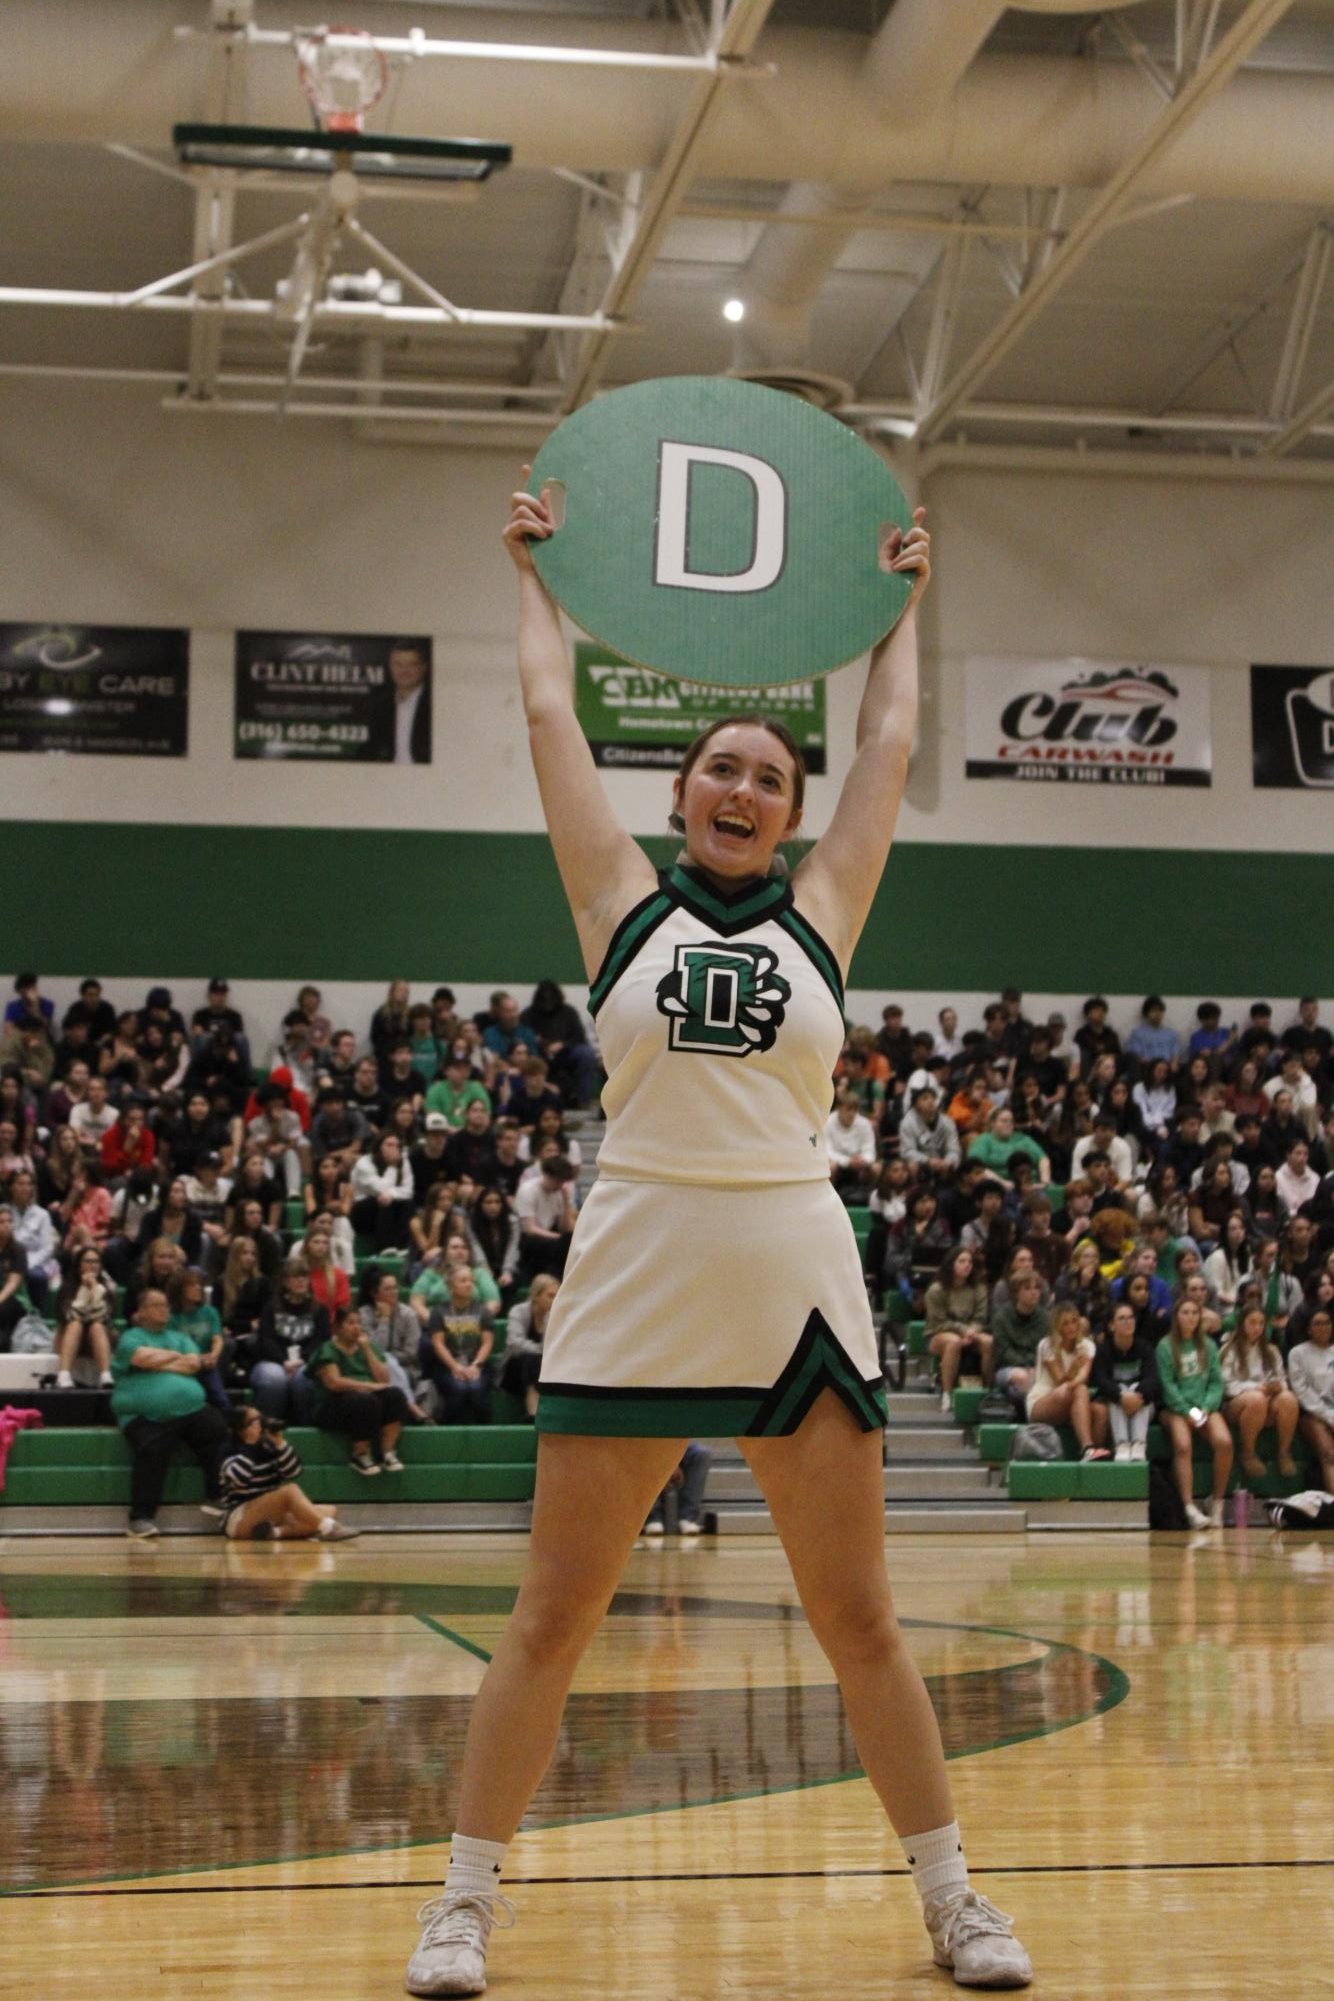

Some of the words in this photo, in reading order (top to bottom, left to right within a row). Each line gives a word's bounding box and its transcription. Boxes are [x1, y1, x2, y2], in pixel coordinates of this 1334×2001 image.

[653, 439, 788, 594] D
[251, 662, 317, 682] CLINT
[322, 664, 385, 685] HELM
[99, 674, 175, 697] CARE
[1000, 691, 1178, 747] Club
[602, 746, 686, 764] CitizensBa
[997, 745, 1174, 765] CARWASH
[1015, 765, 1059, 779] JOIN
[1067, 766, 1100, 781] THE
[668, 943, 765, 1058] D
